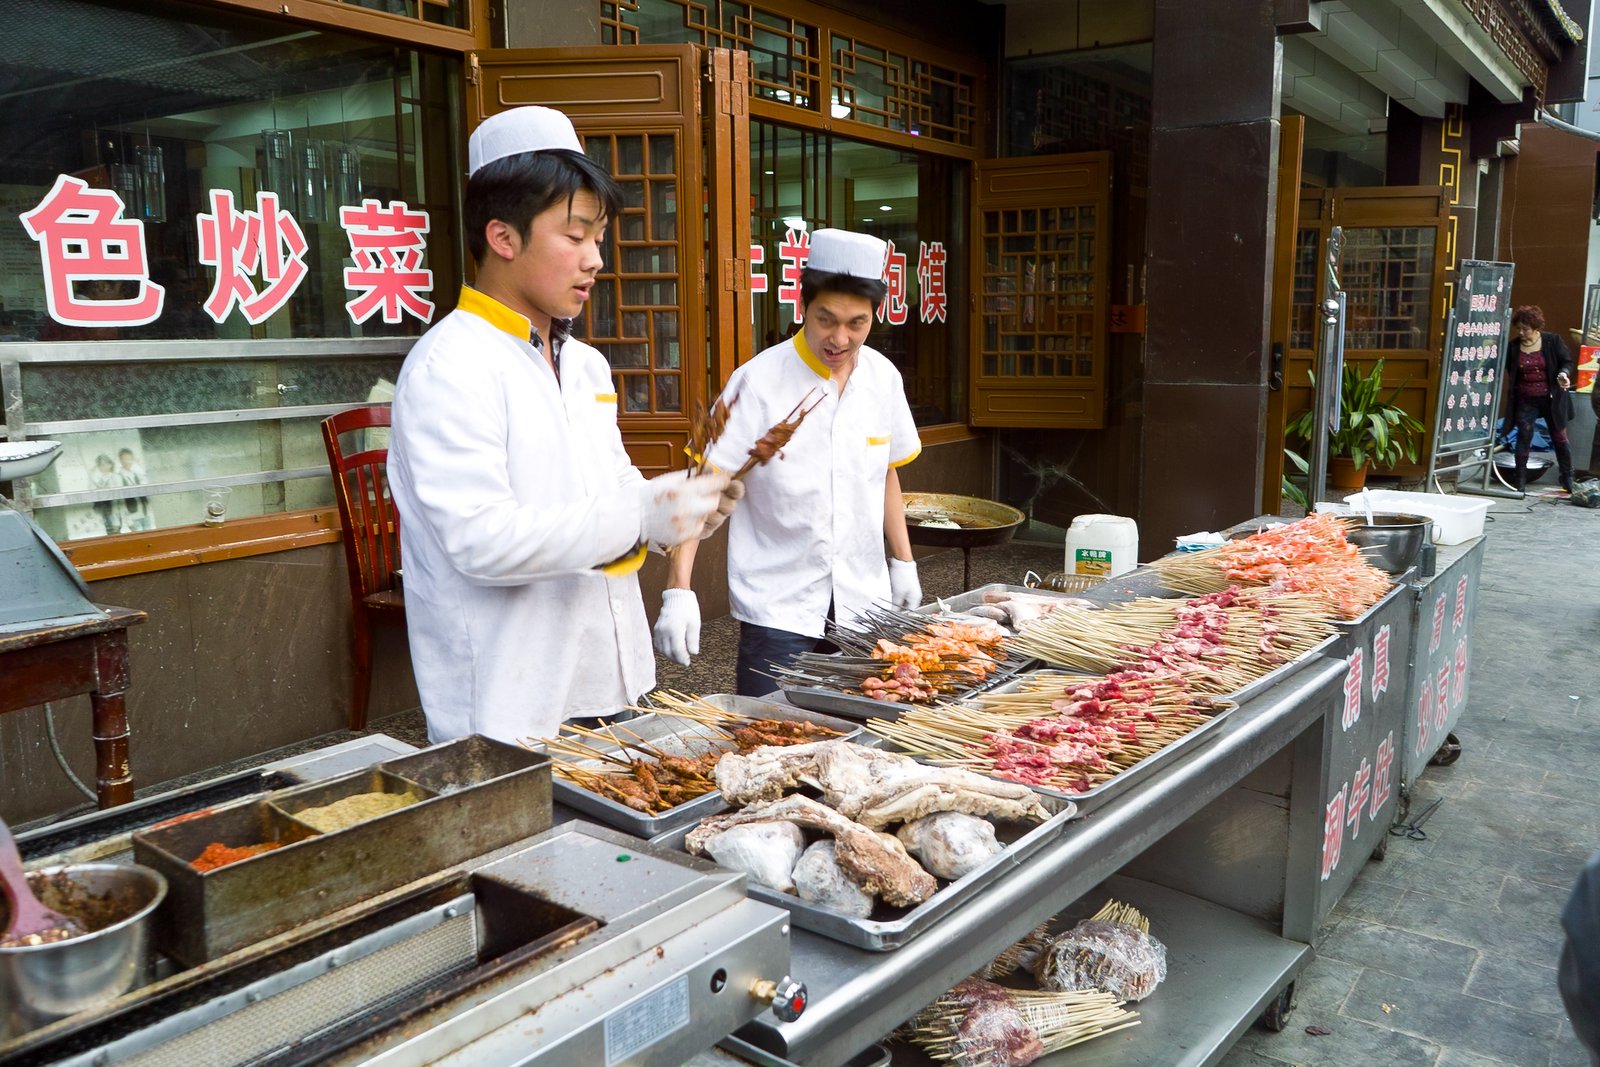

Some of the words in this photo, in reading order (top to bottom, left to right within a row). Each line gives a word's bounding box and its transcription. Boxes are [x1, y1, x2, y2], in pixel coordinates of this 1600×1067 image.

[20, 174, 434, 327] 色炒菜
[1429, 574, 1468, 656] 清真
[1342, 624, 1390, 731] 清真
